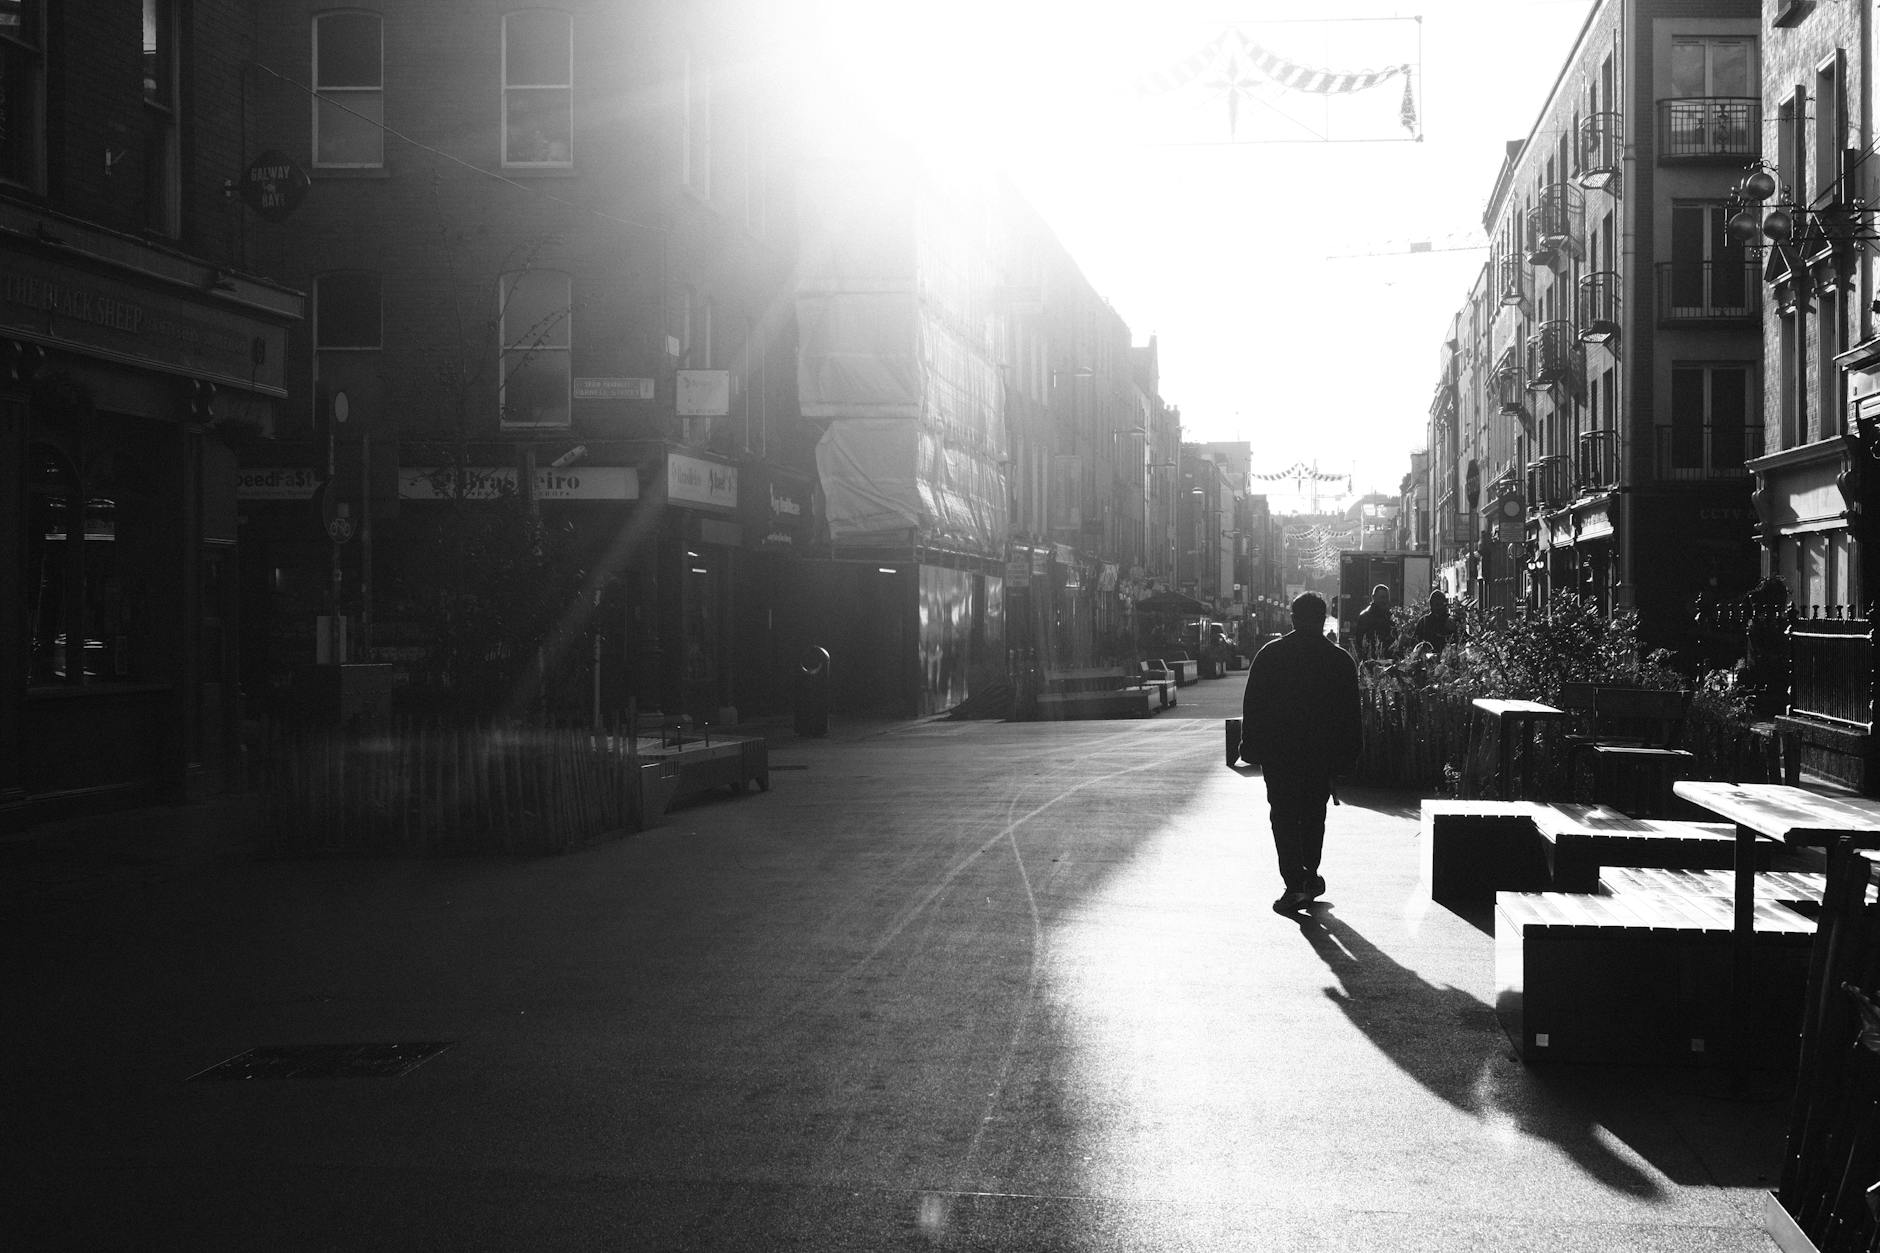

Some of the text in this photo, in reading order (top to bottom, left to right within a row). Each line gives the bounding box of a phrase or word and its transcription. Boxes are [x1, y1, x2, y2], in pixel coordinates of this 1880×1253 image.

[250, 165, 291, 182] GALWAY
[5, 271, 144, 334] THE BLACK SHEEP
